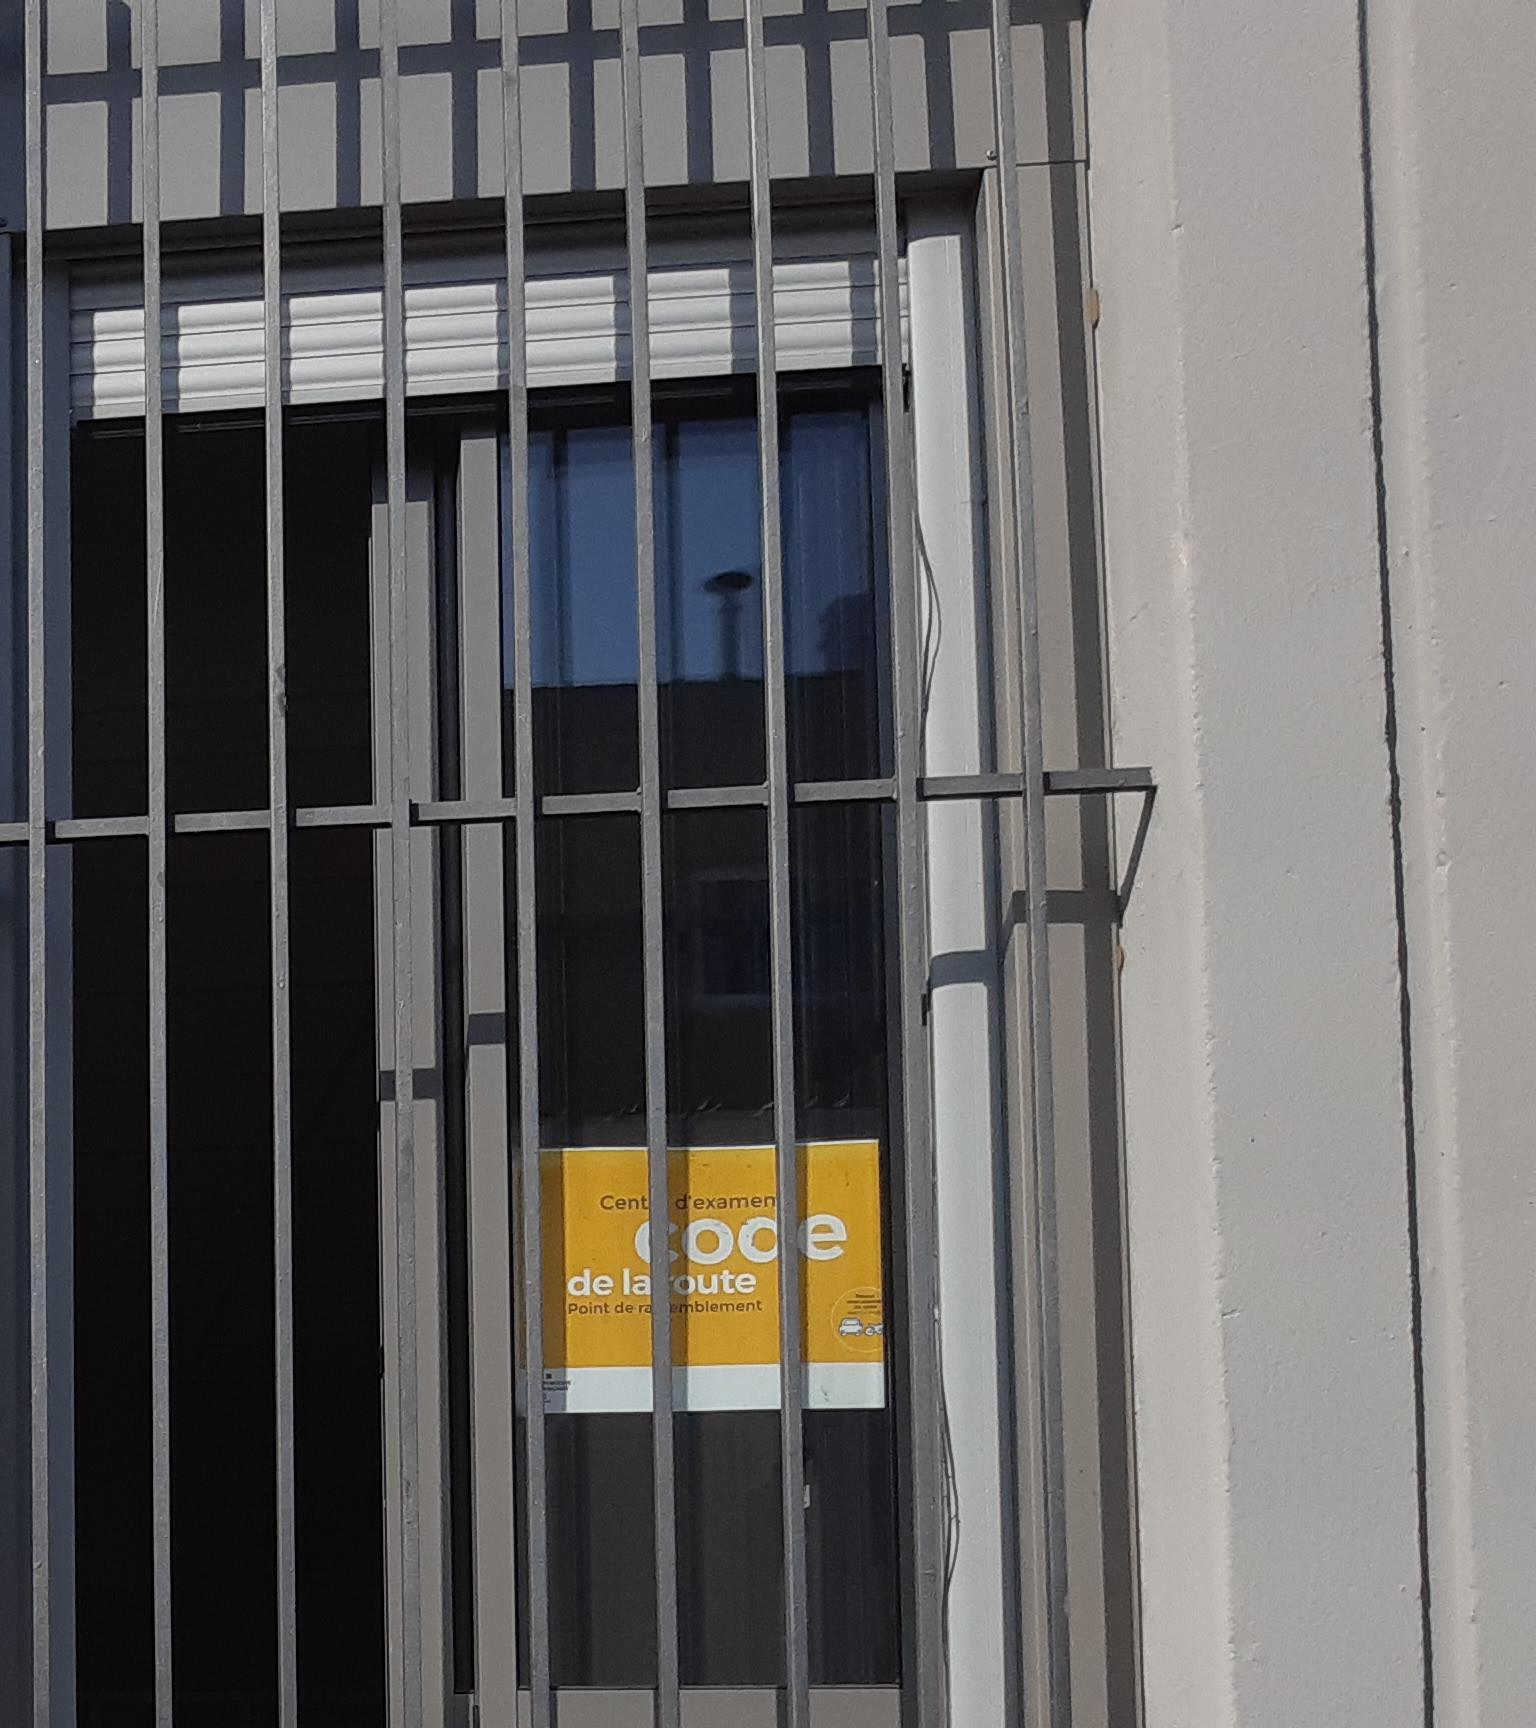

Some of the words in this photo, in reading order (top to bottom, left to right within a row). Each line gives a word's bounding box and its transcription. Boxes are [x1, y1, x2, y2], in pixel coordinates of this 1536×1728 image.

[567, 1268, 614, 1296] de
[622, 1268, 651, 1296] la
[568, 1302, 609, 1314] Point
[614, 1302, 634, 1314] de
